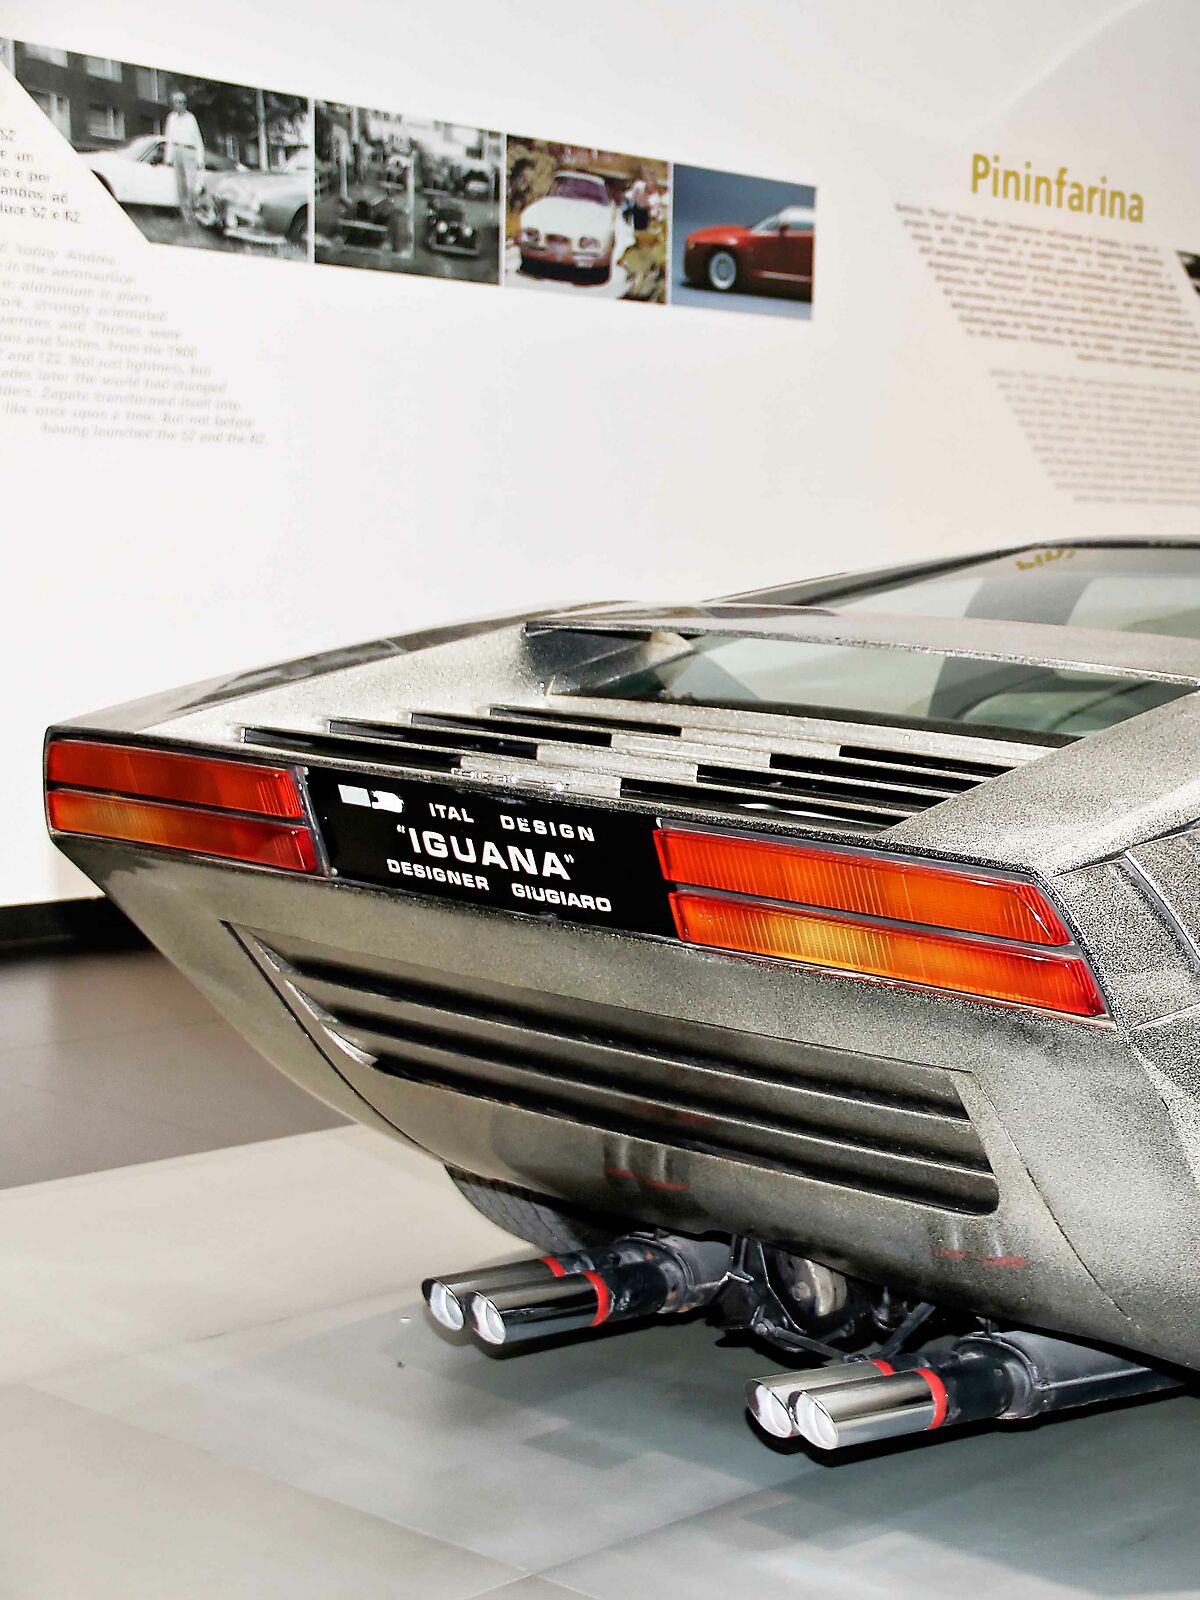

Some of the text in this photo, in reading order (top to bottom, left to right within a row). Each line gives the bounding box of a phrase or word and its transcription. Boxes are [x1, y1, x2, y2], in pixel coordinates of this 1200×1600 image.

[971, 153, 1145, 223] Pininfarina
[429, 803, 596, 842] ITAL DESIGN
[386, 858, 612, 912] DESIGNER GIUGIARO
